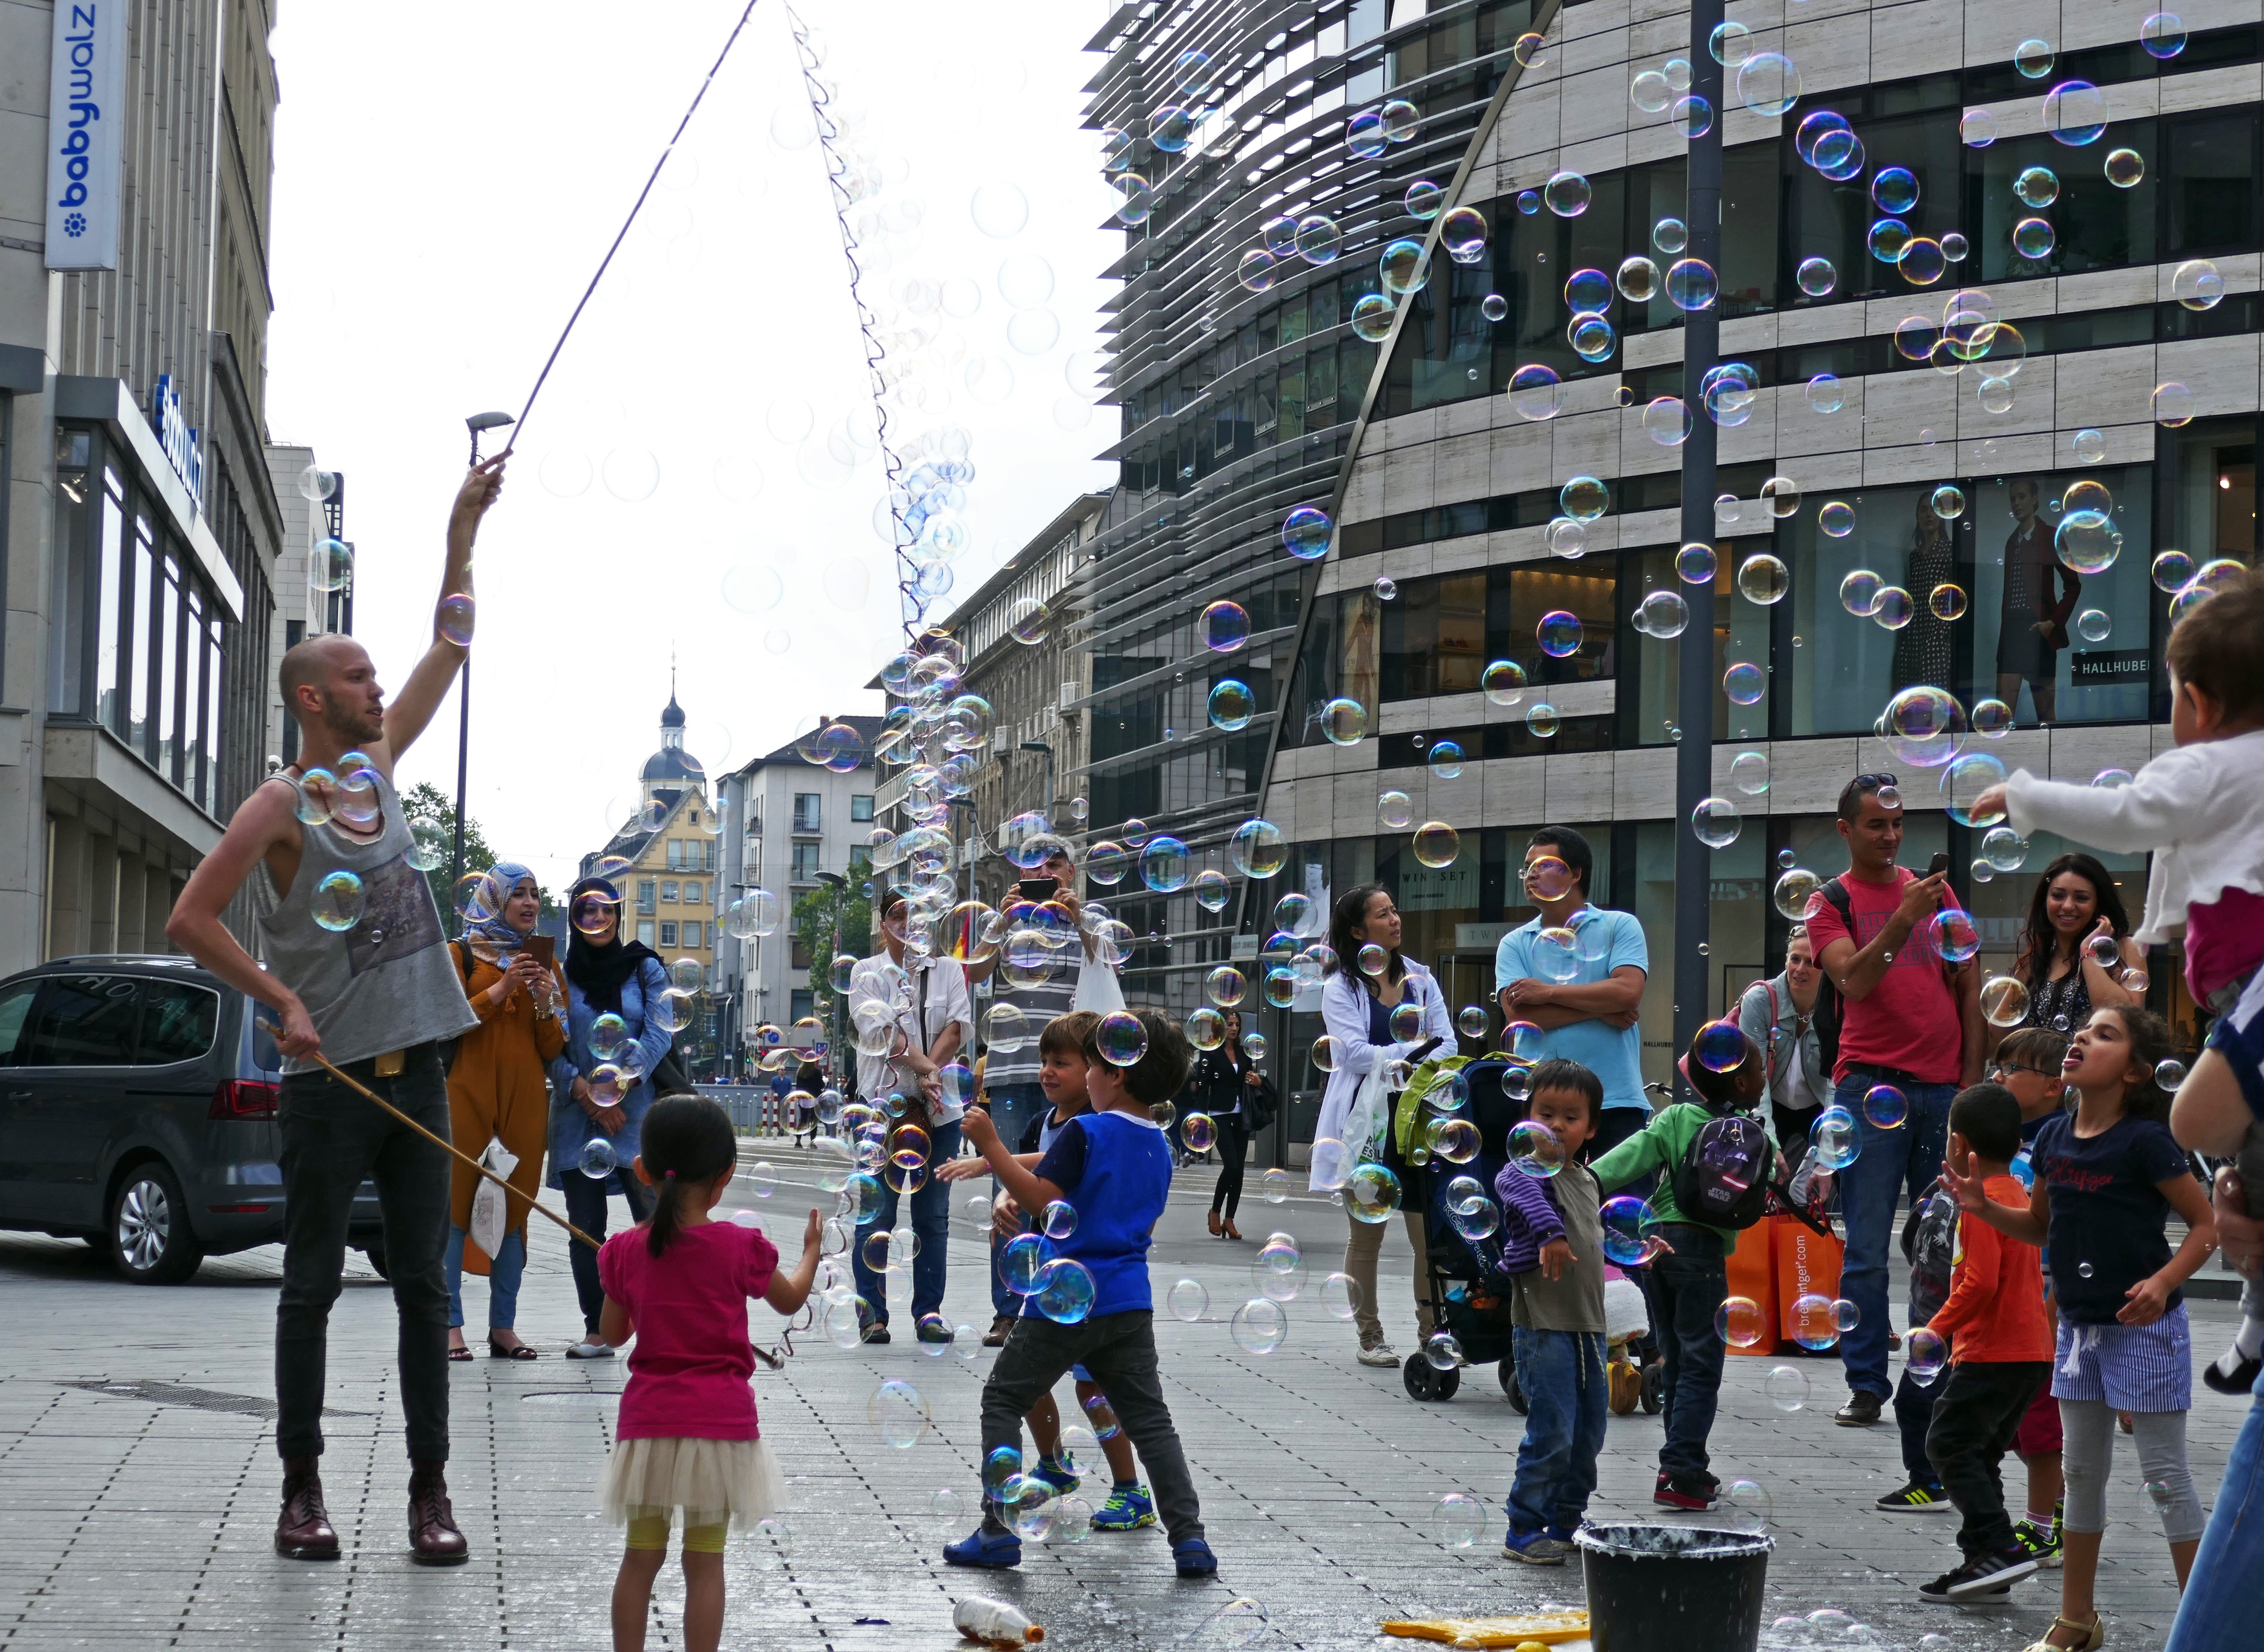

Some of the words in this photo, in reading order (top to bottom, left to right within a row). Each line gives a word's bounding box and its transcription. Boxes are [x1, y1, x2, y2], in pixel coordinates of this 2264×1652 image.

[58, 3, 100, 207] babywalz
[2082, 659, 2150, 674] HALLHUBE
[2046, 1156, 2114, 1192] Hilfiger
[1708, 1187, 1731, 1197] STAR
[1708, 1191, 1731, 1202] WARS
[1796, 1235, 1810, 1326] breuninger.com
